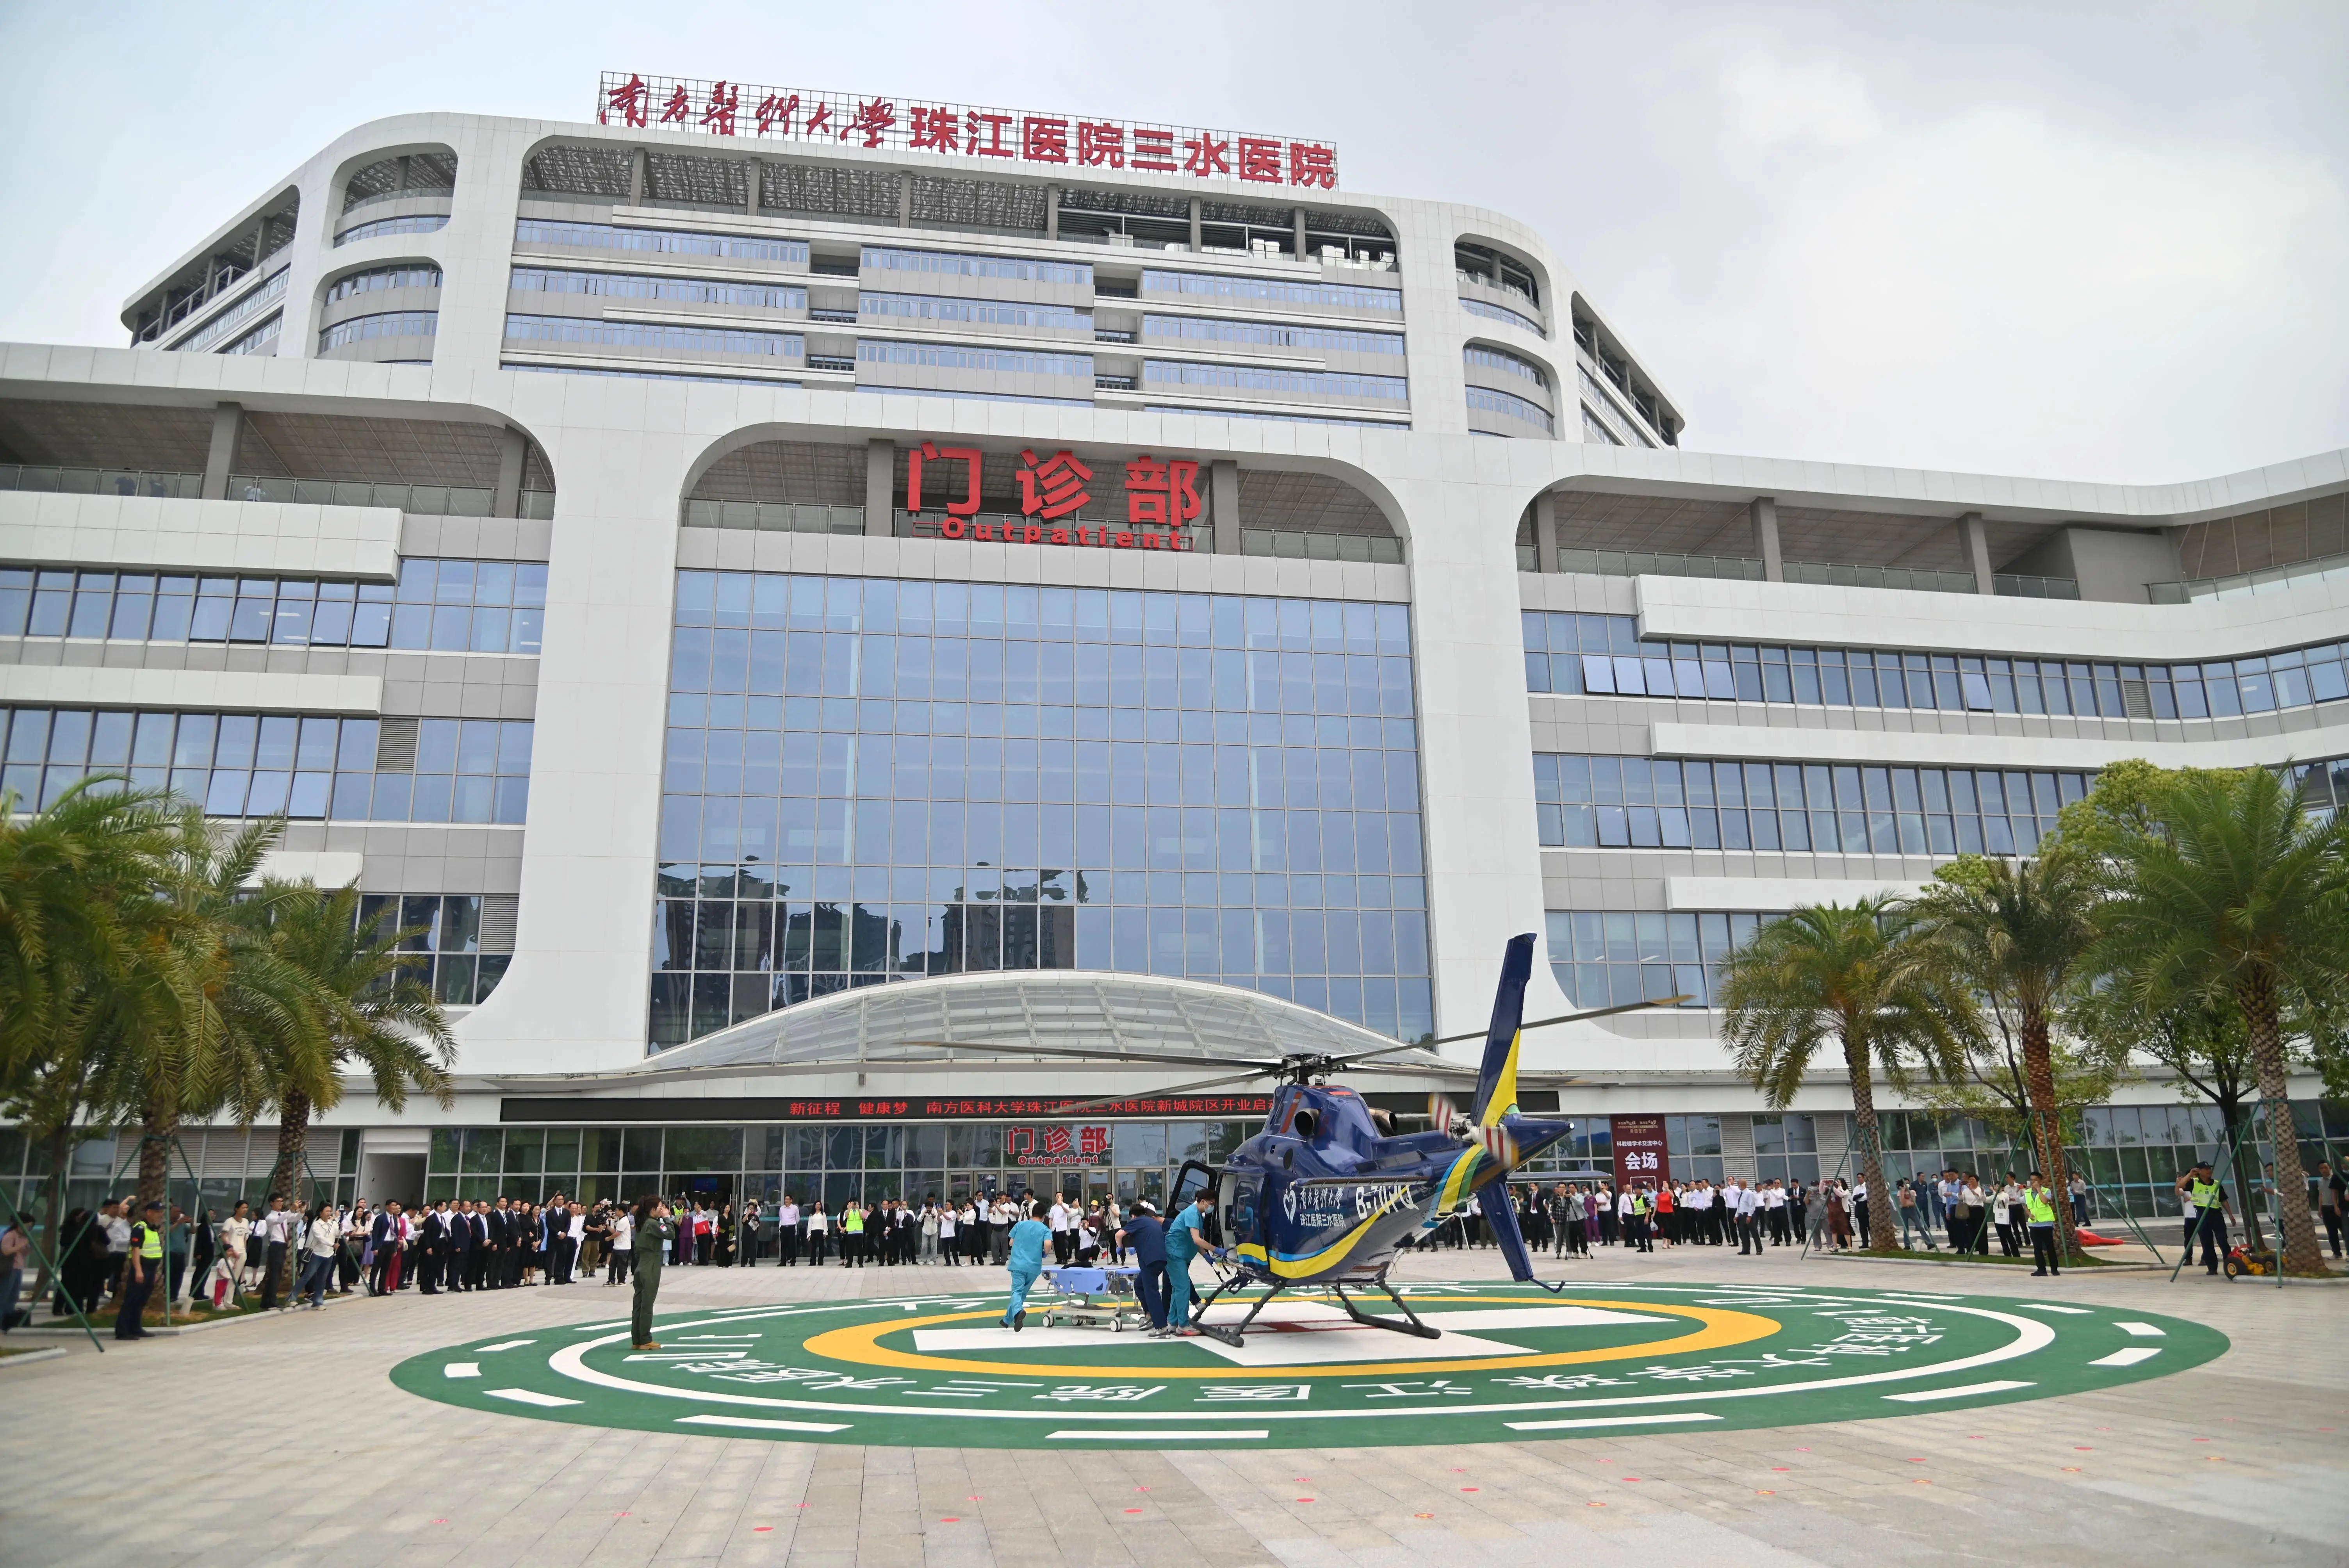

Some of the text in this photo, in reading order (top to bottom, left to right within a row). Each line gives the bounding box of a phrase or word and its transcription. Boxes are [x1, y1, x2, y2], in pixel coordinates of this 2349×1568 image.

[907, 441, 1201, 526] 门诊部
[942, 517, 1182, 550] Outpatient
[790, 1102, 840, 1115] 新征程
[859, 1101, 908, 1115] 健康梦
[1008, 1126, 1108, 1154] 门诊部
[1018, 1155, 1098, 1166] Outpatient
[1625, 1151, 1658, 1170] 会场
[1300, 1213, 1346, 1228] 珠江医院三水医院
